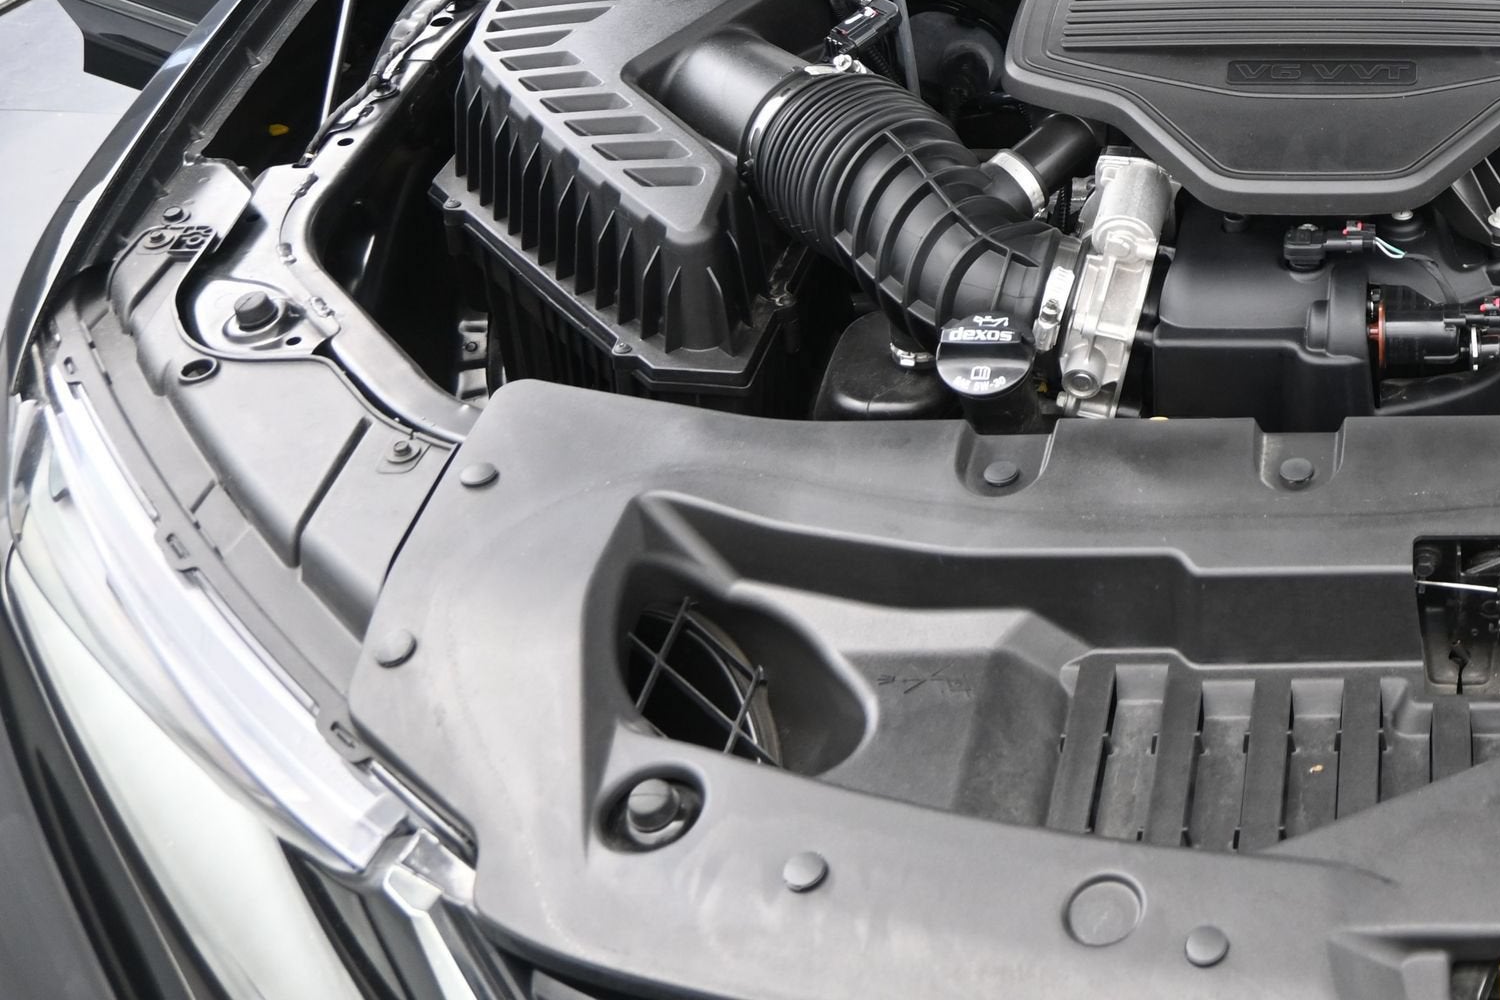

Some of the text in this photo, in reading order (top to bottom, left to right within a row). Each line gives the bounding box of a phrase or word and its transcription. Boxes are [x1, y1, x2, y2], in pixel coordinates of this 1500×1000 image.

[1235, 63, 1410, 80] V6 VVT
[949, 327, 1013, 342] dexos
